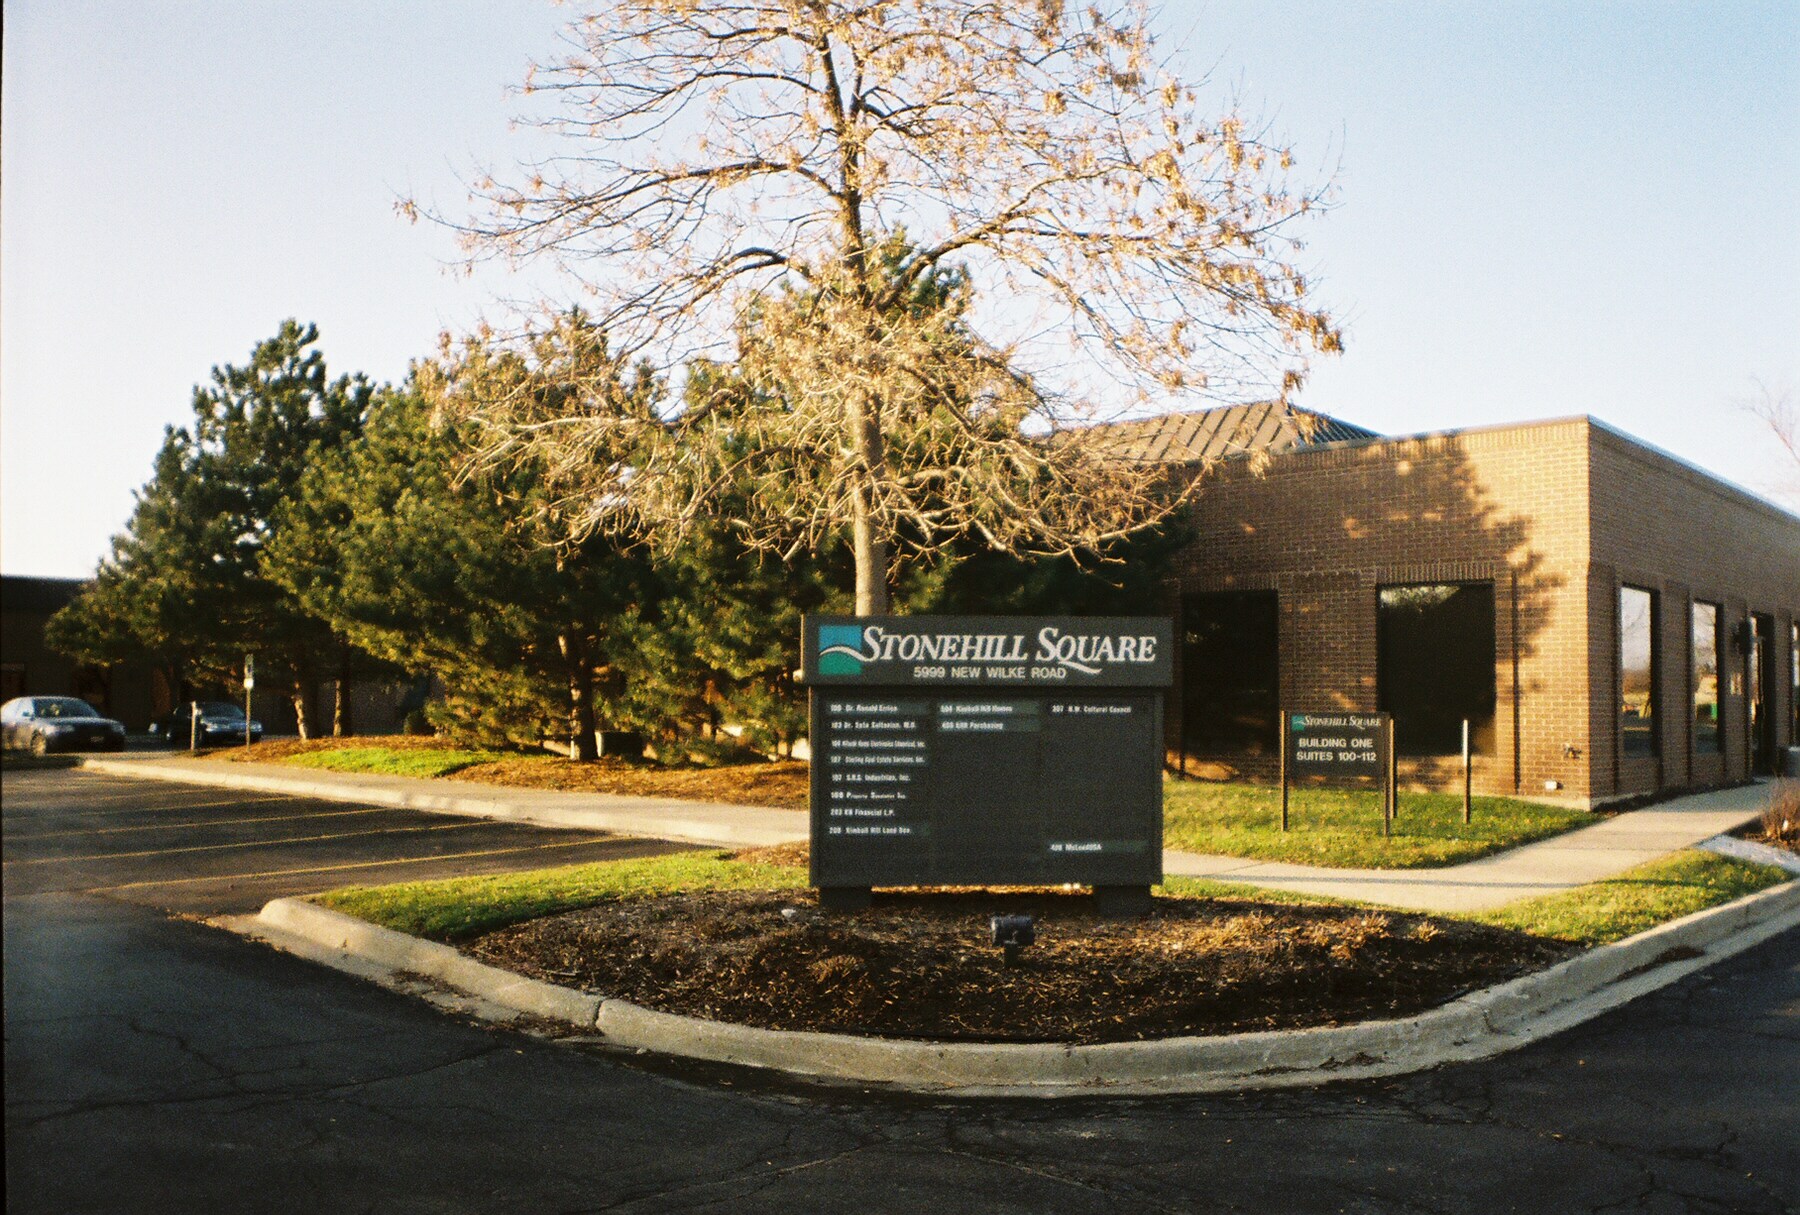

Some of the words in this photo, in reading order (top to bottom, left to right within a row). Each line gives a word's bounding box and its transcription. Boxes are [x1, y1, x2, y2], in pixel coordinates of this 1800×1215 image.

[863, 626, 1028, 662] STONEHILL
[1036, 626, 1157, 674] SQUARE
[914, 667, 945, 679] 5999
[952, 667, 981, 679] NEW
[987, 667, 1025, 679] WILKE
[1031, 667, 1067, 679] ROAD
[1304, 715, 1347, 726] STONEHILL
[1349, 715, 1381, 729] SQUARE
[1299, 738, 1347, 748] BUILDING
[1351, 738, 1373, 748] ONE
[1296, 751, 1333, 761] SUITES
[1339, 751, 1377, 761] 100-112
